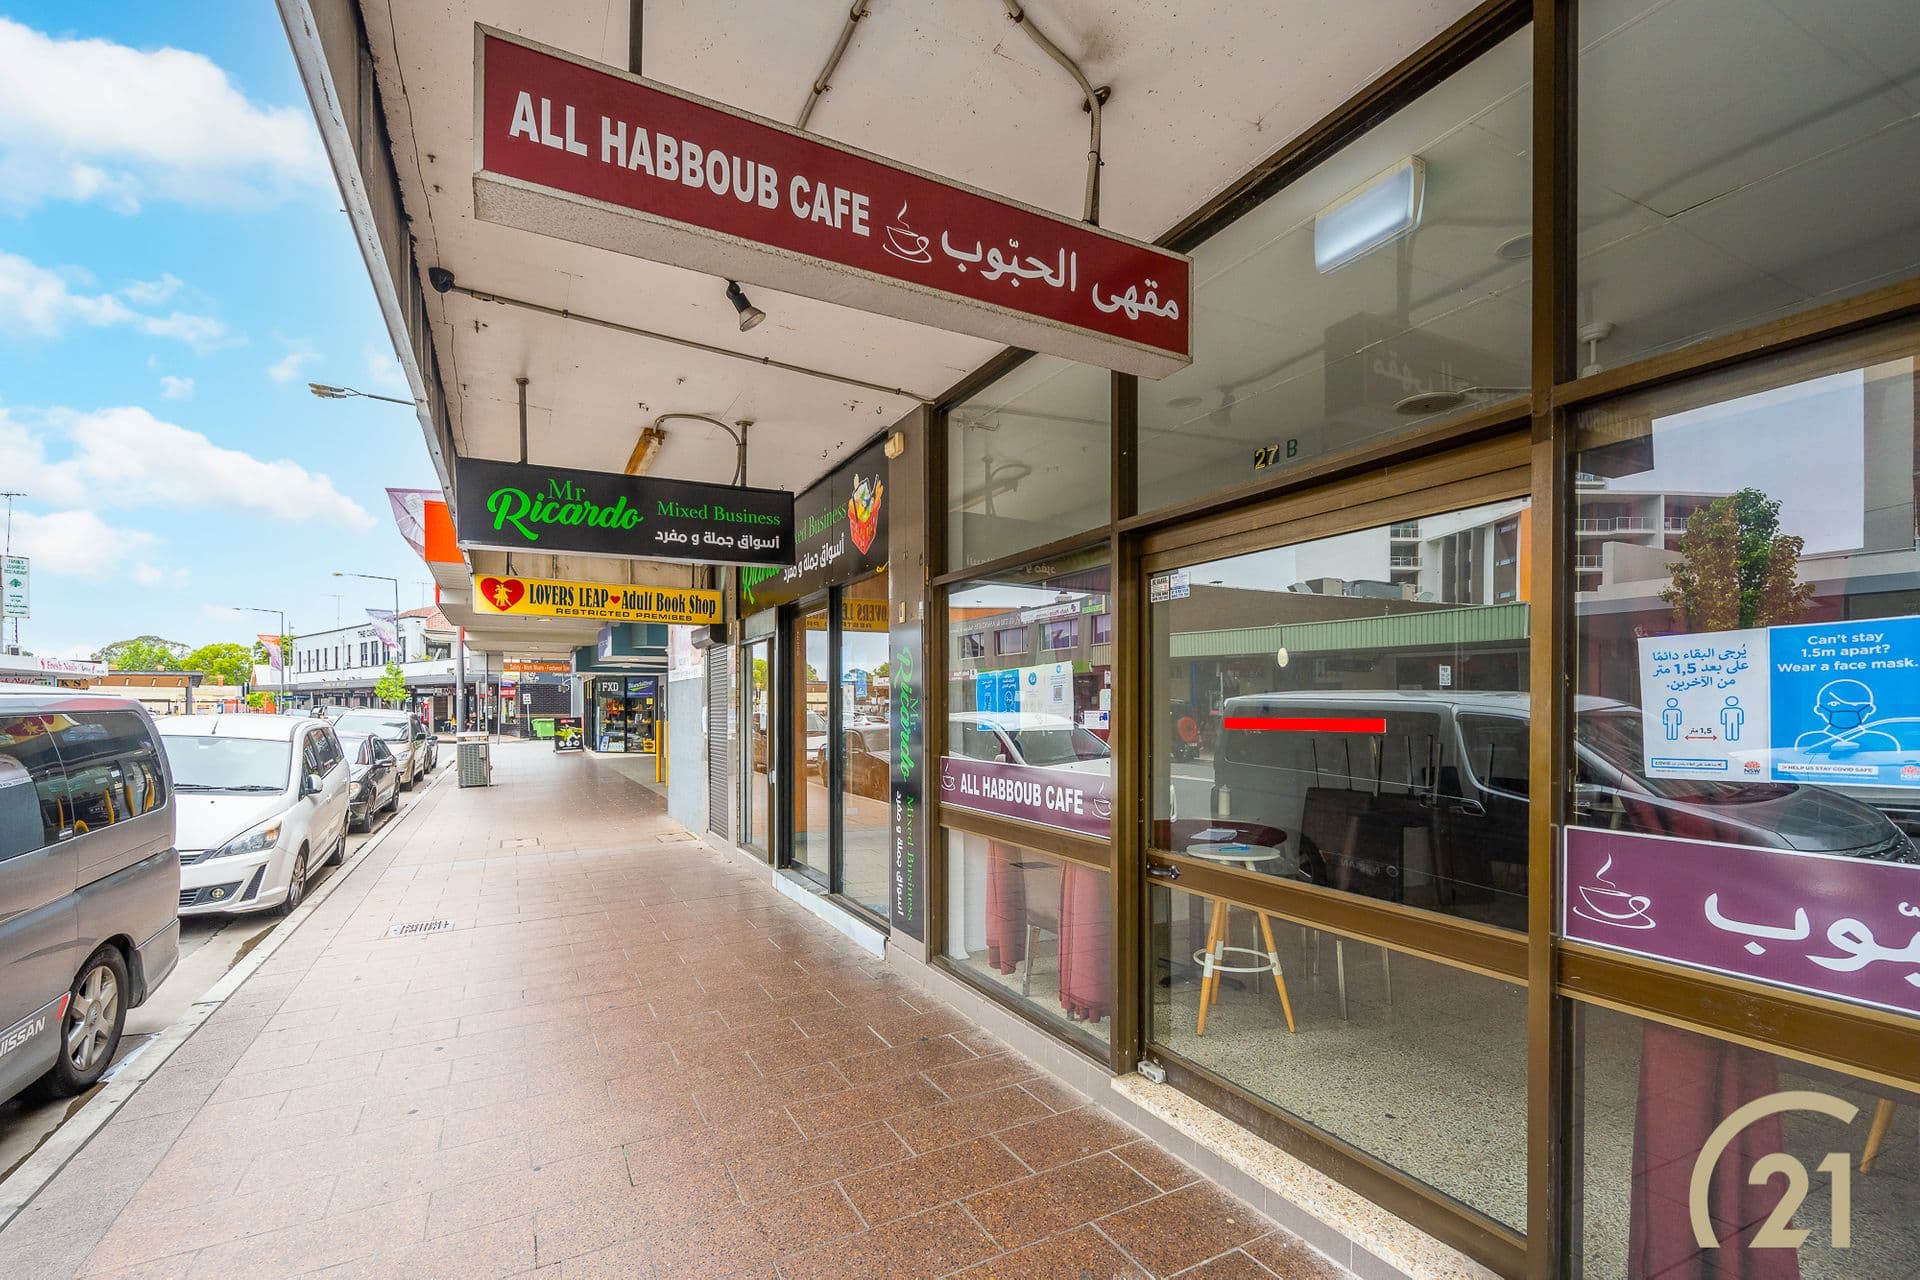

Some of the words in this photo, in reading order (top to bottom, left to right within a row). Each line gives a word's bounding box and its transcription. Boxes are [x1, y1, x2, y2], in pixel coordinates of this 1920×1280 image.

[508, 90, 588, 157] ALL
[601, 115, 779, 210] HABBOUB
[789, 175, 870, 237] CAFE
[1092, 278, 1180, 321] مقهى
[1254, 445, 1279, 470] 27
[1286, 439, 1297, 458] B
[548, 478, 585, 501] Mr
[486, 487, 644, 541] Ricardo
[657, 500, 708, 520] Mixed
[713, 505, 781, 526] Business
[809, 502, 847, 538] Business
[655, 529, 688, 543] مفرد
[691, 533, 699, 545] و
[703, 531, 734, 548] جملة
[737, 535, 780, 549] أسواق
[820, 531, 845, 568] أسواق
[798, 560, 803, 578] و
[803, 552, 818, 571] جملة
[529, 583, 574, 607] LOVERS
[579, 587, 609, 608] LEAP
[621, 590, 652, 611] Adult
[656, 593, 686, 613] Book
[689, 595, 716, 618] Shop
[556, 608, 630, 618] RESTRICTED
[636, 612, 693, 622] PREMISES
[1807, 634, 1847, 645] Can't
[1852, 632, 1884, 643] stay
[1683, 647, 1715, 661] البقاء
[1801, 648, 1836, 658] 1.5m
[1840, 643, 1891, 657] apart?
[1652, 664, 1671, 677] متر
[1673, 662, 1697, 676] 1,5
[1701, 663, 1722, 674] بعد
[1726, 660, 1749, 674] على
[1777, 663, 1817, 672] Wear
[1821, 663, 1829, 671] a
[1834, 660, 1867, 670] face
[1871, 657, 1919, 669] mask.
[602, 682, 619, 692] FXD
[1717, 677, 1736, 688] من
[893, 646, 915, 783] Ricardo
[960, 773, 980, 796] ALL
[982, 776, 1041, 807] HABBOUB
[1045, 785, 1084, 815] CAFE
